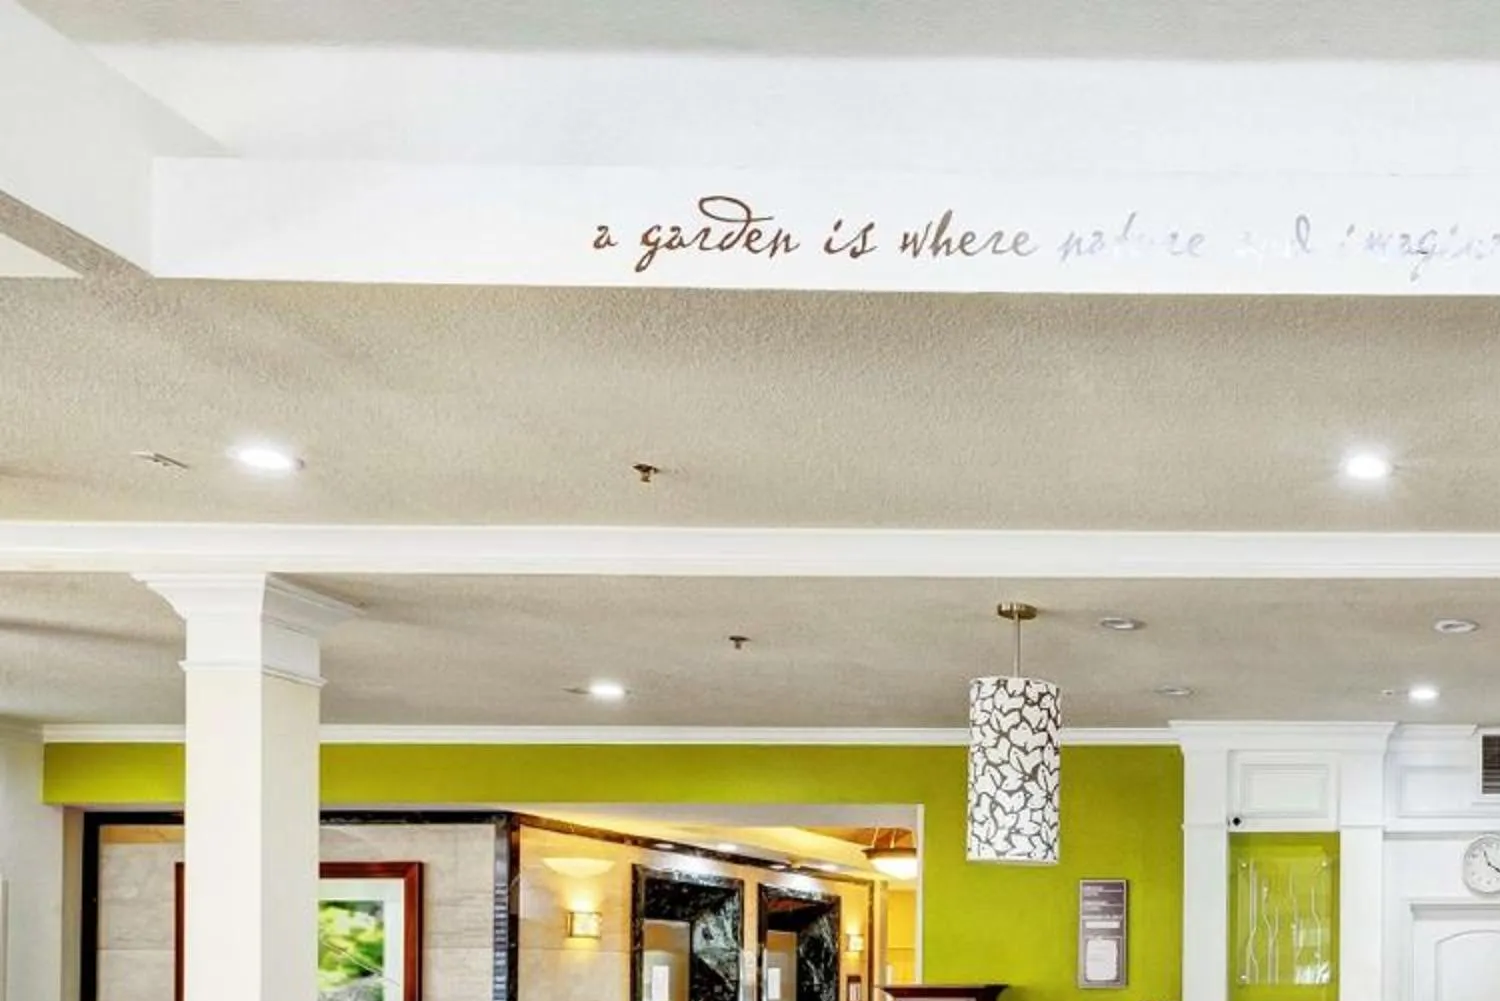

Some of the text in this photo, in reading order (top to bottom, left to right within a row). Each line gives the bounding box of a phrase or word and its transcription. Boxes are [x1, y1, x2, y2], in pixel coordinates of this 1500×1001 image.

[592, 222, 616, 249] a
[635, 195, 799, 272] garden
[823, 218, 877, 257] is
[899, 209, 1042, 260] where
[1057, 209, 1206, 265] natre
